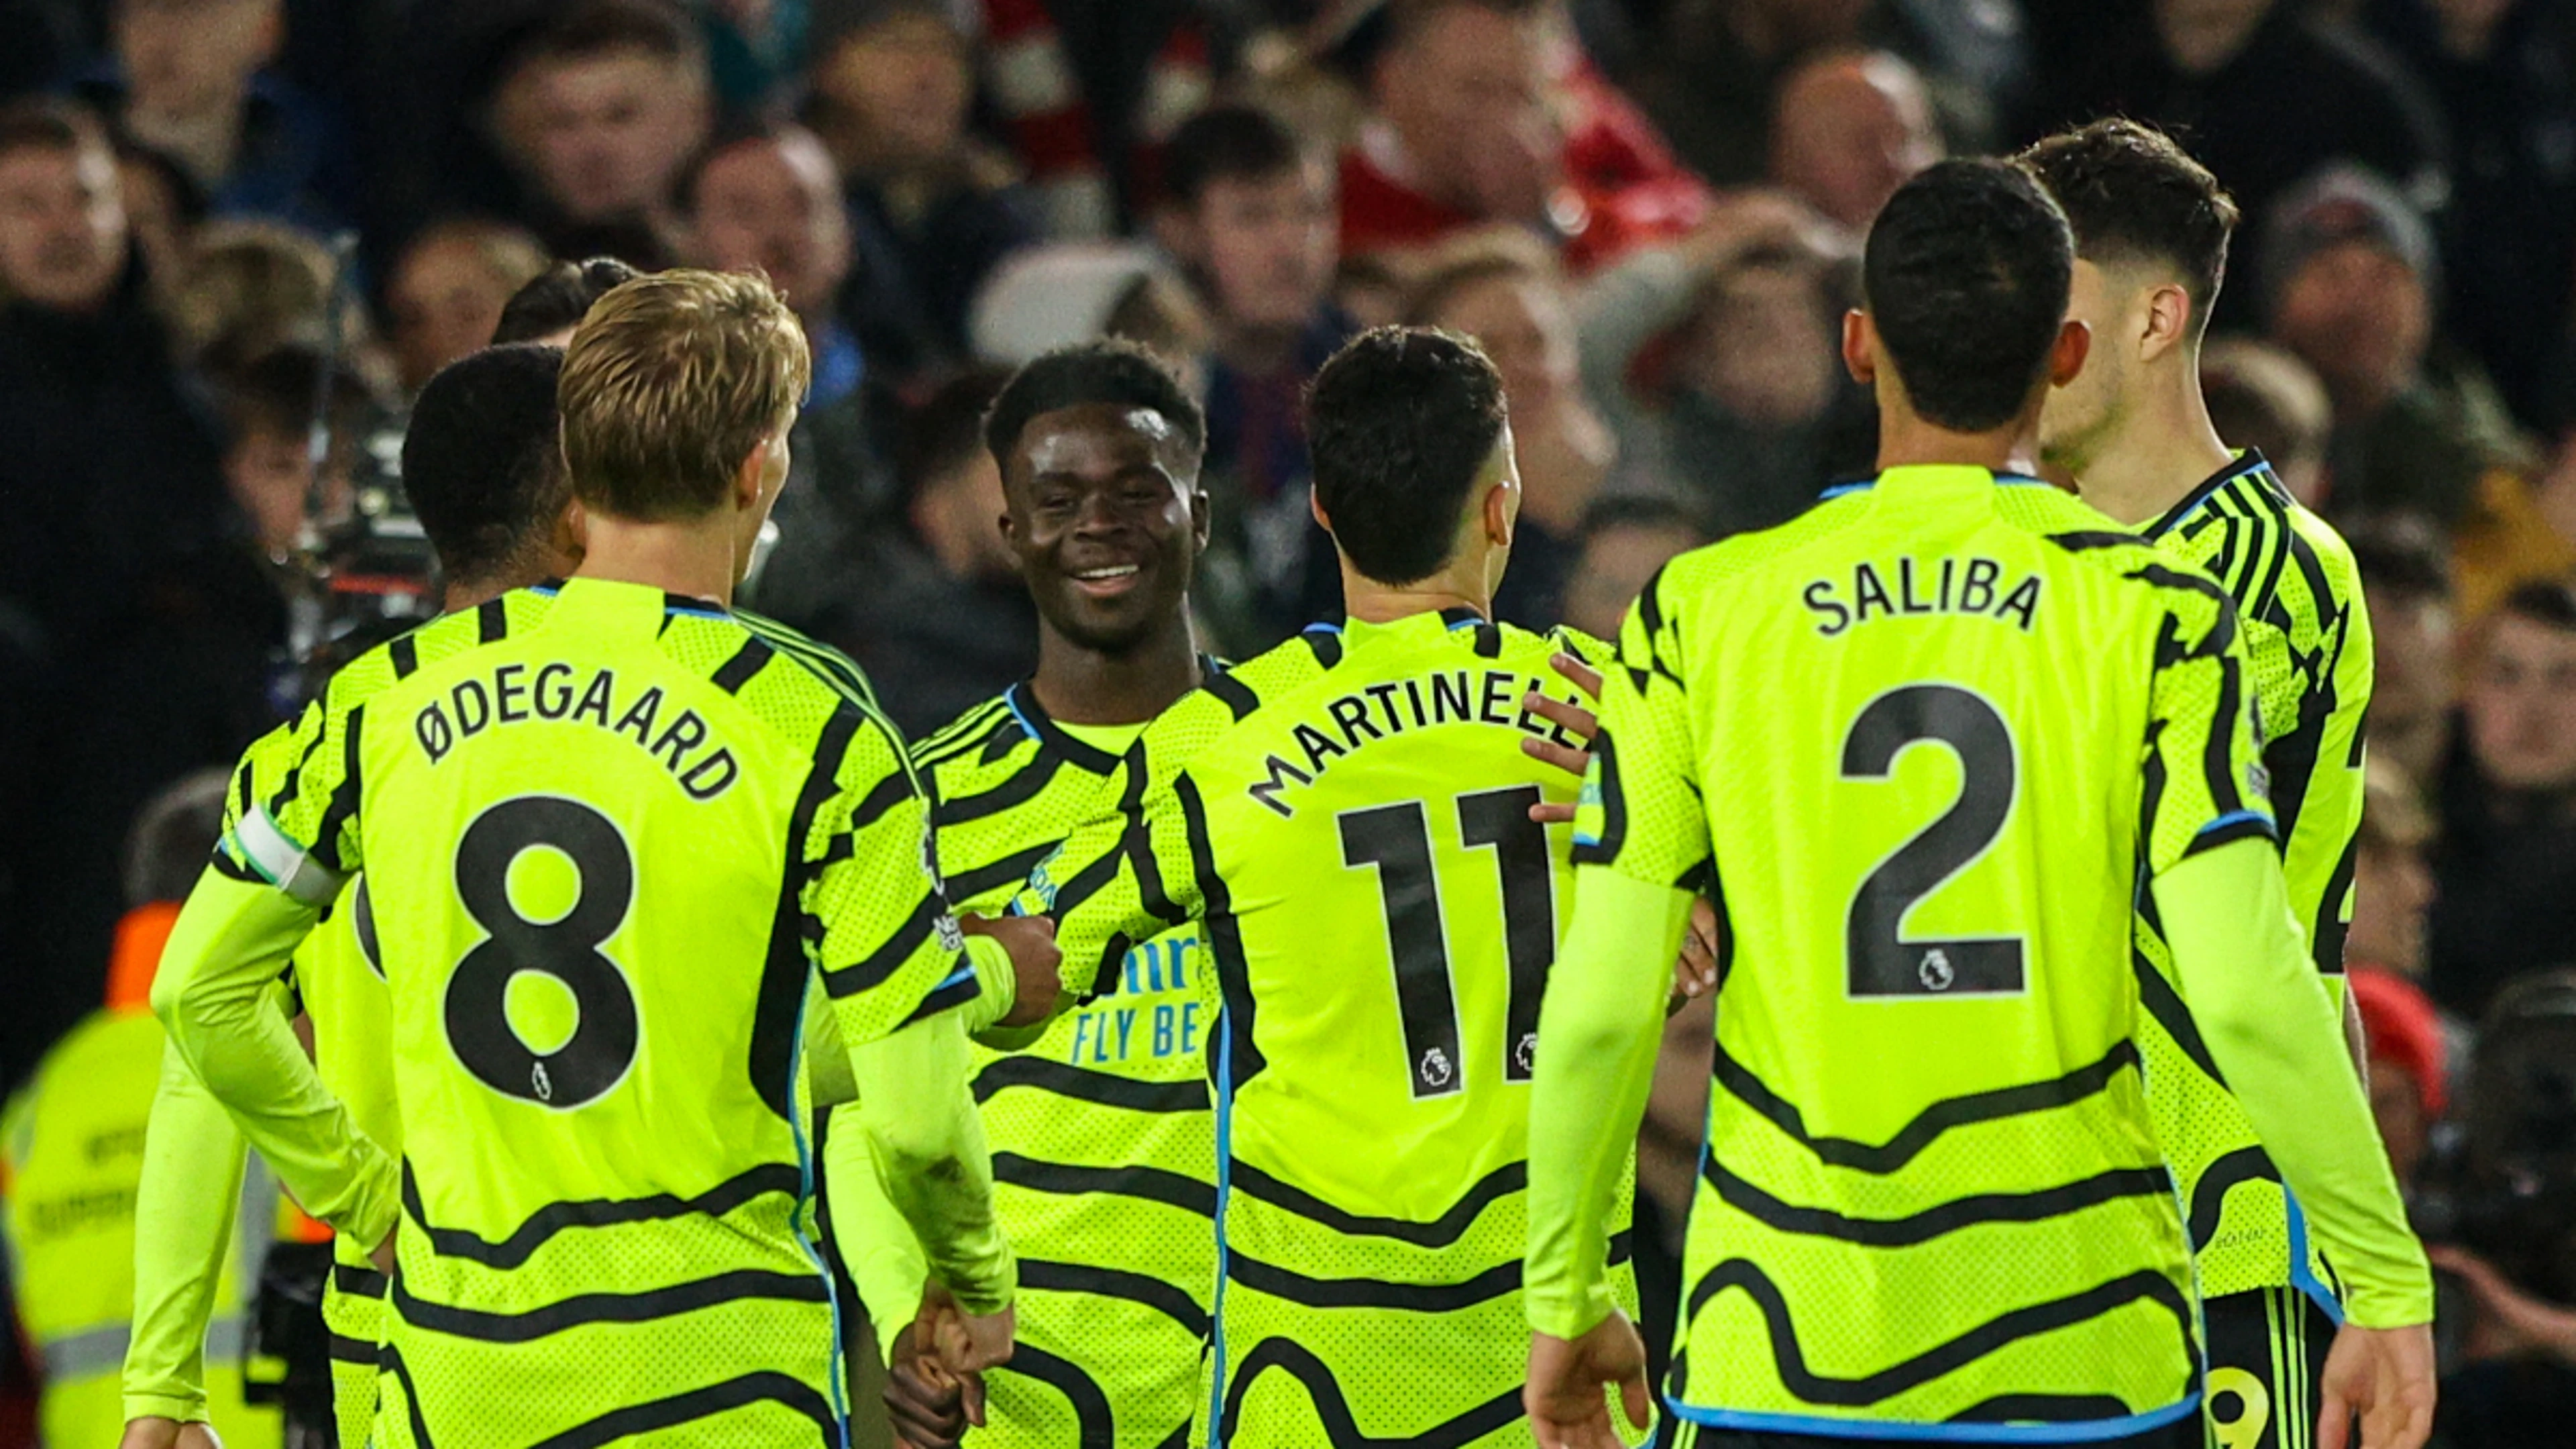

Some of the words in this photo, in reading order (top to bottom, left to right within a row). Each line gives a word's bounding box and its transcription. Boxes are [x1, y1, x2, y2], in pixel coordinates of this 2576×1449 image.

[1803, 557, 2041, 636] SALIBA
[415, 663, 738, 800] ØDEGAARD
[1248, 671, 1591, 818] MARTINELL
[1841, 683, 2026, 998] 2
[442, 793, 641, 1112] 8
[1337, 784, 1558, 1101] 11
[1071, 1008, 1136, 1066] FLY
